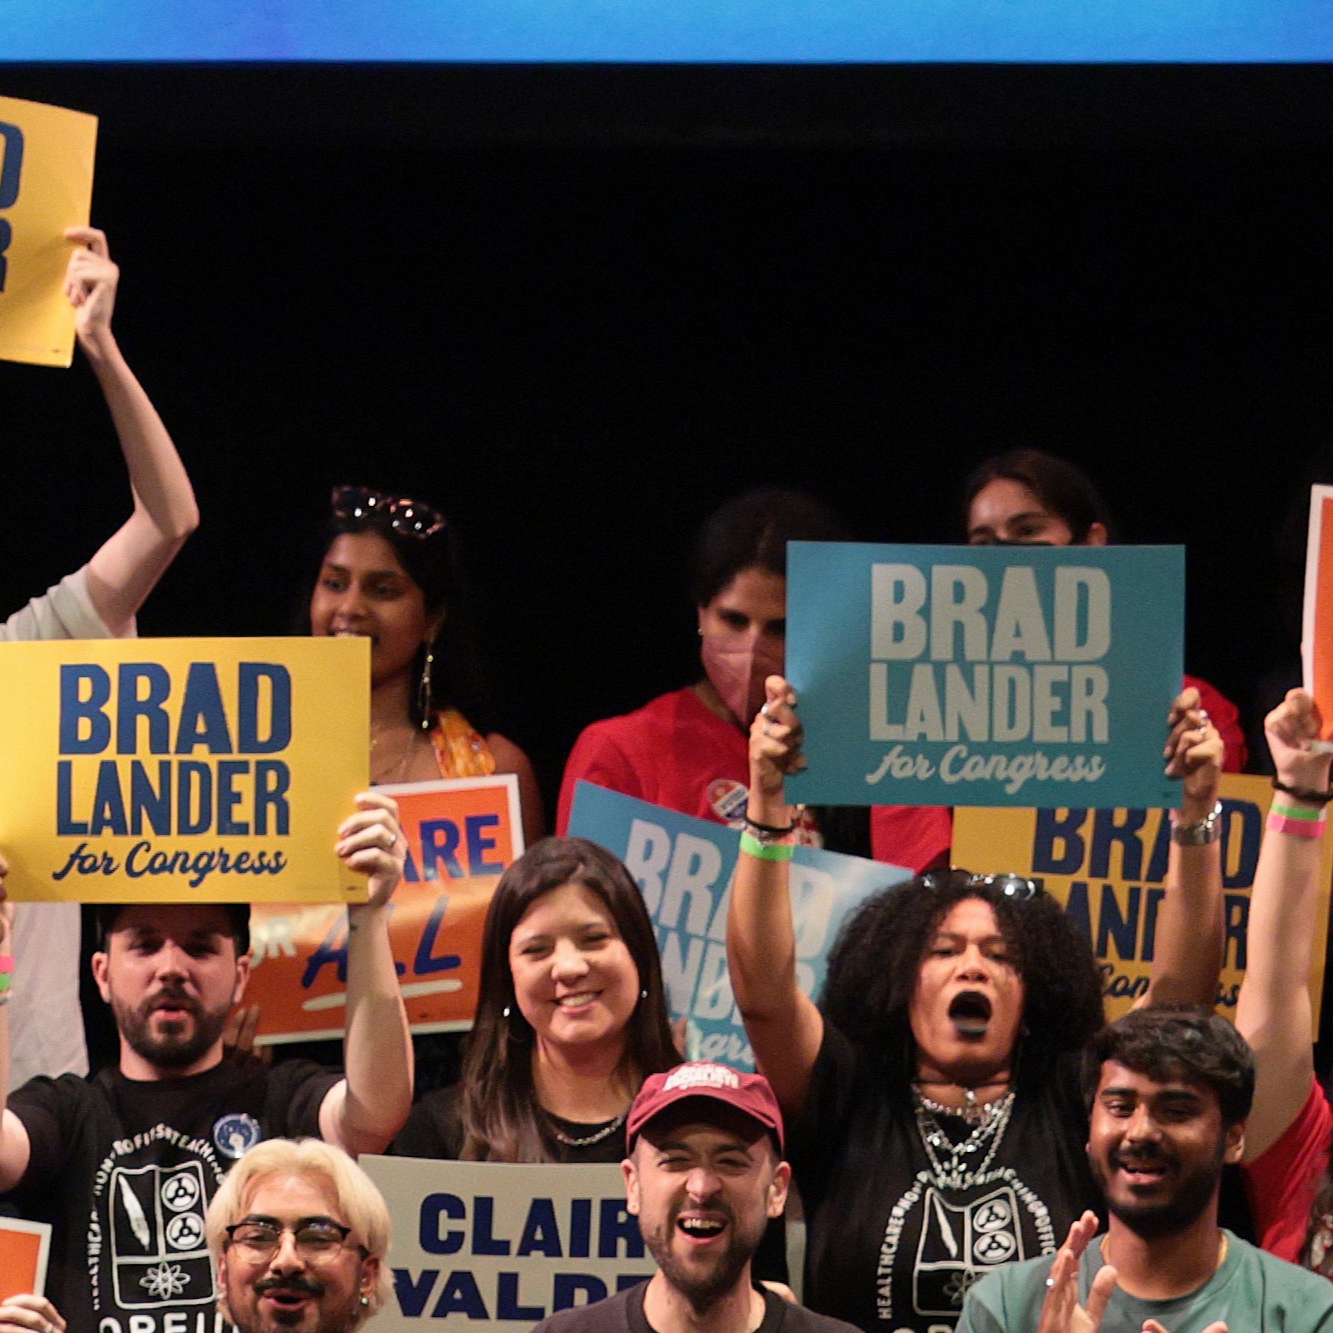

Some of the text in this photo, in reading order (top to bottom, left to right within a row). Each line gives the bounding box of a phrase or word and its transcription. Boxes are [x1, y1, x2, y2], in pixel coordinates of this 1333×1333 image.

[871, 562, 1112, 661] BRAD
[58, 660, 292, 755] BRAD
[869, 662, 1109, 744] LANDER
[55, 759, 291, 836] LANDER
[865, 743, 1106, 794] for Congress
[52, 841, 287, 888] for Congress
[1032, 797, 1262, 889] BRD
[624, 818, 835, 959] BRD
[419, 1192, 646, 1259] CLAIR
